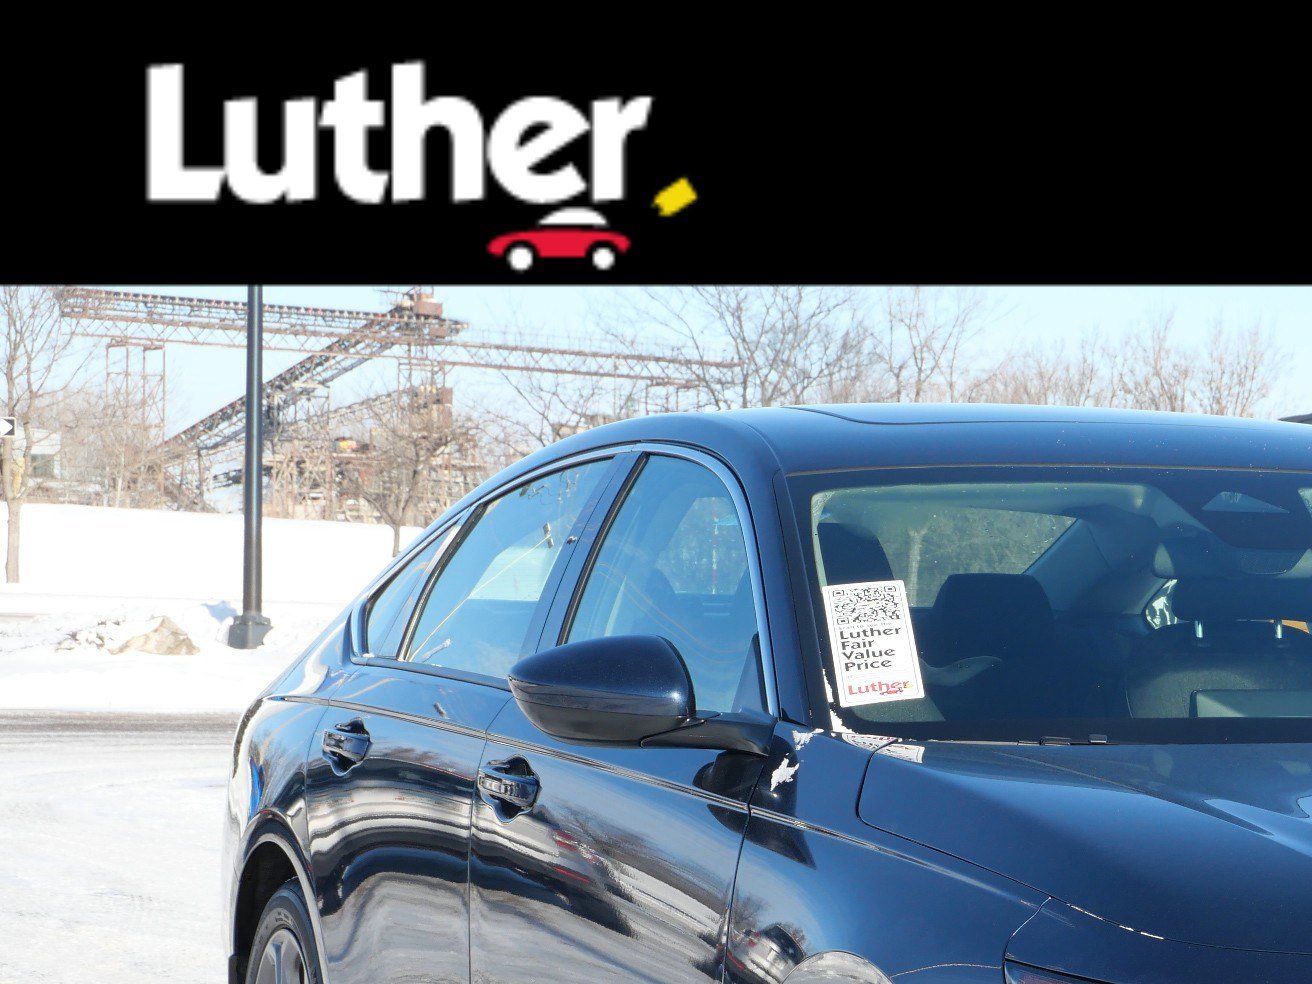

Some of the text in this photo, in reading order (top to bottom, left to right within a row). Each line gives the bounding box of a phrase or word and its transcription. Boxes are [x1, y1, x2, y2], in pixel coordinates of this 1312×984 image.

[840, 627, 901, 640] Luther
[841, 638, 875, 651] Fair
[842, 648, 896, 661] Value
[845, 659, 893, 672] Price
[847, 680, 910, 696] Luther
